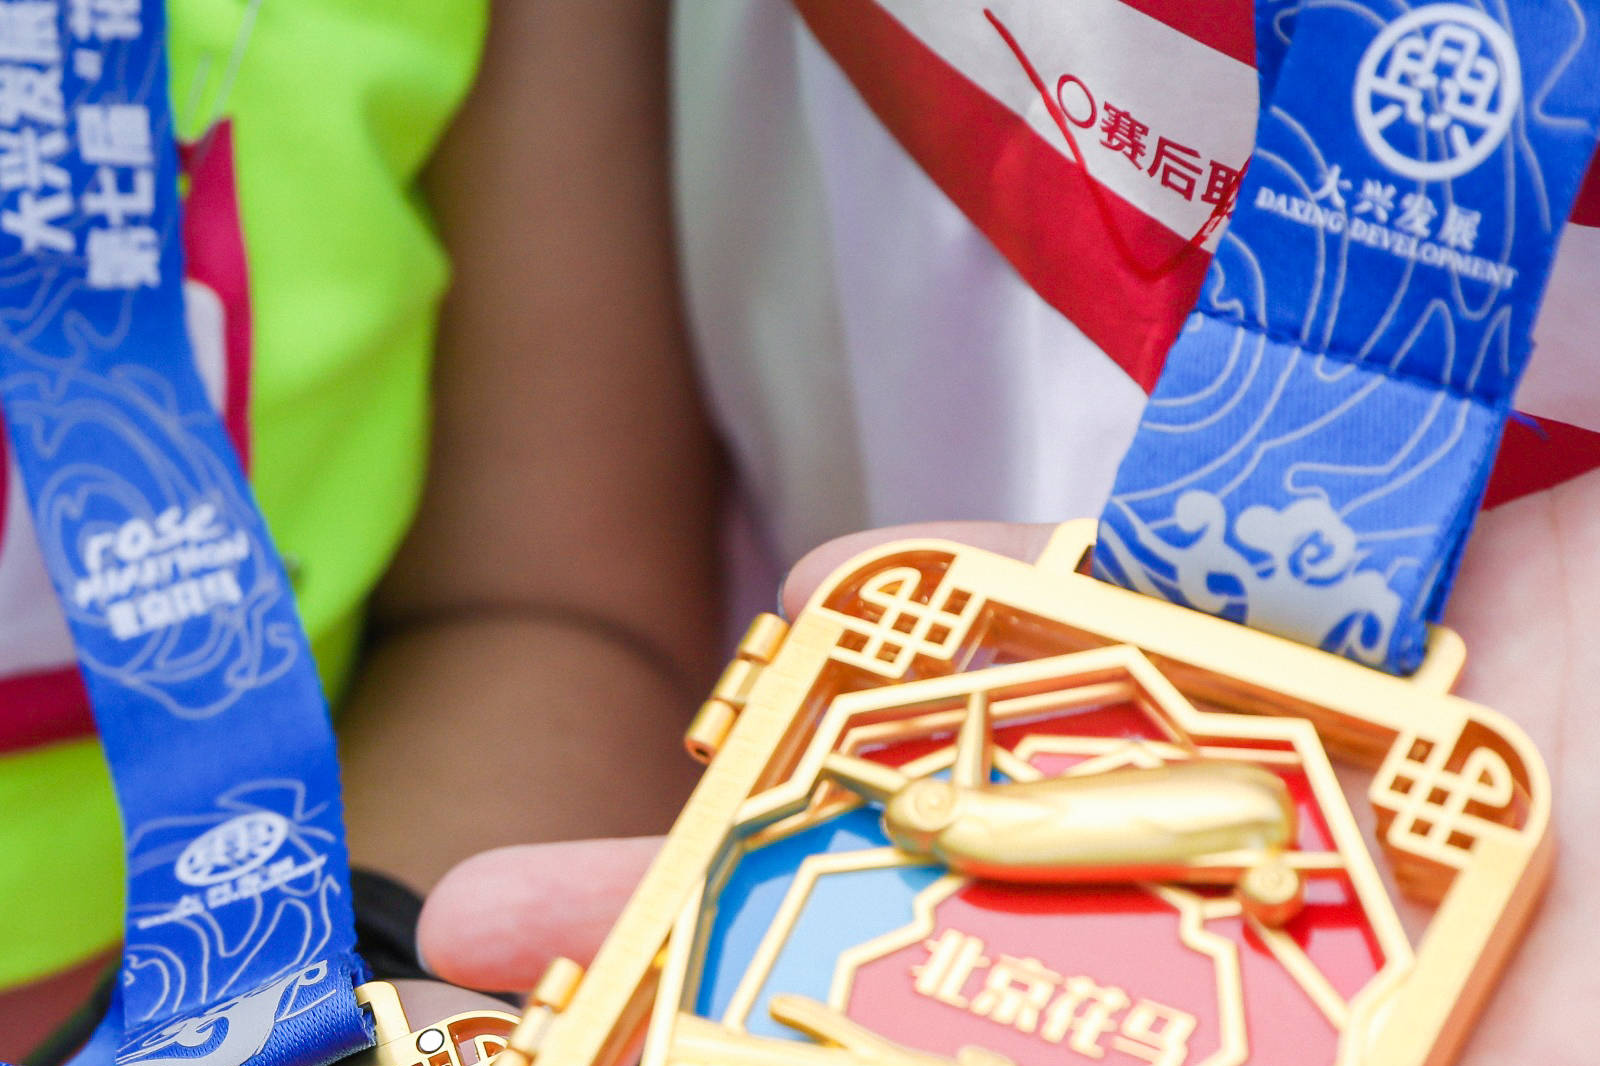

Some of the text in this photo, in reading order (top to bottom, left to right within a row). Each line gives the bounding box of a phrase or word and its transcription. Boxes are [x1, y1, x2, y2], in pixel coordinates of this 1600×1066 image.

[1254, 185, 1519, 289] DAXING DEVELOPMENT
[1309, 164, 1483, 252] 大兴发展
